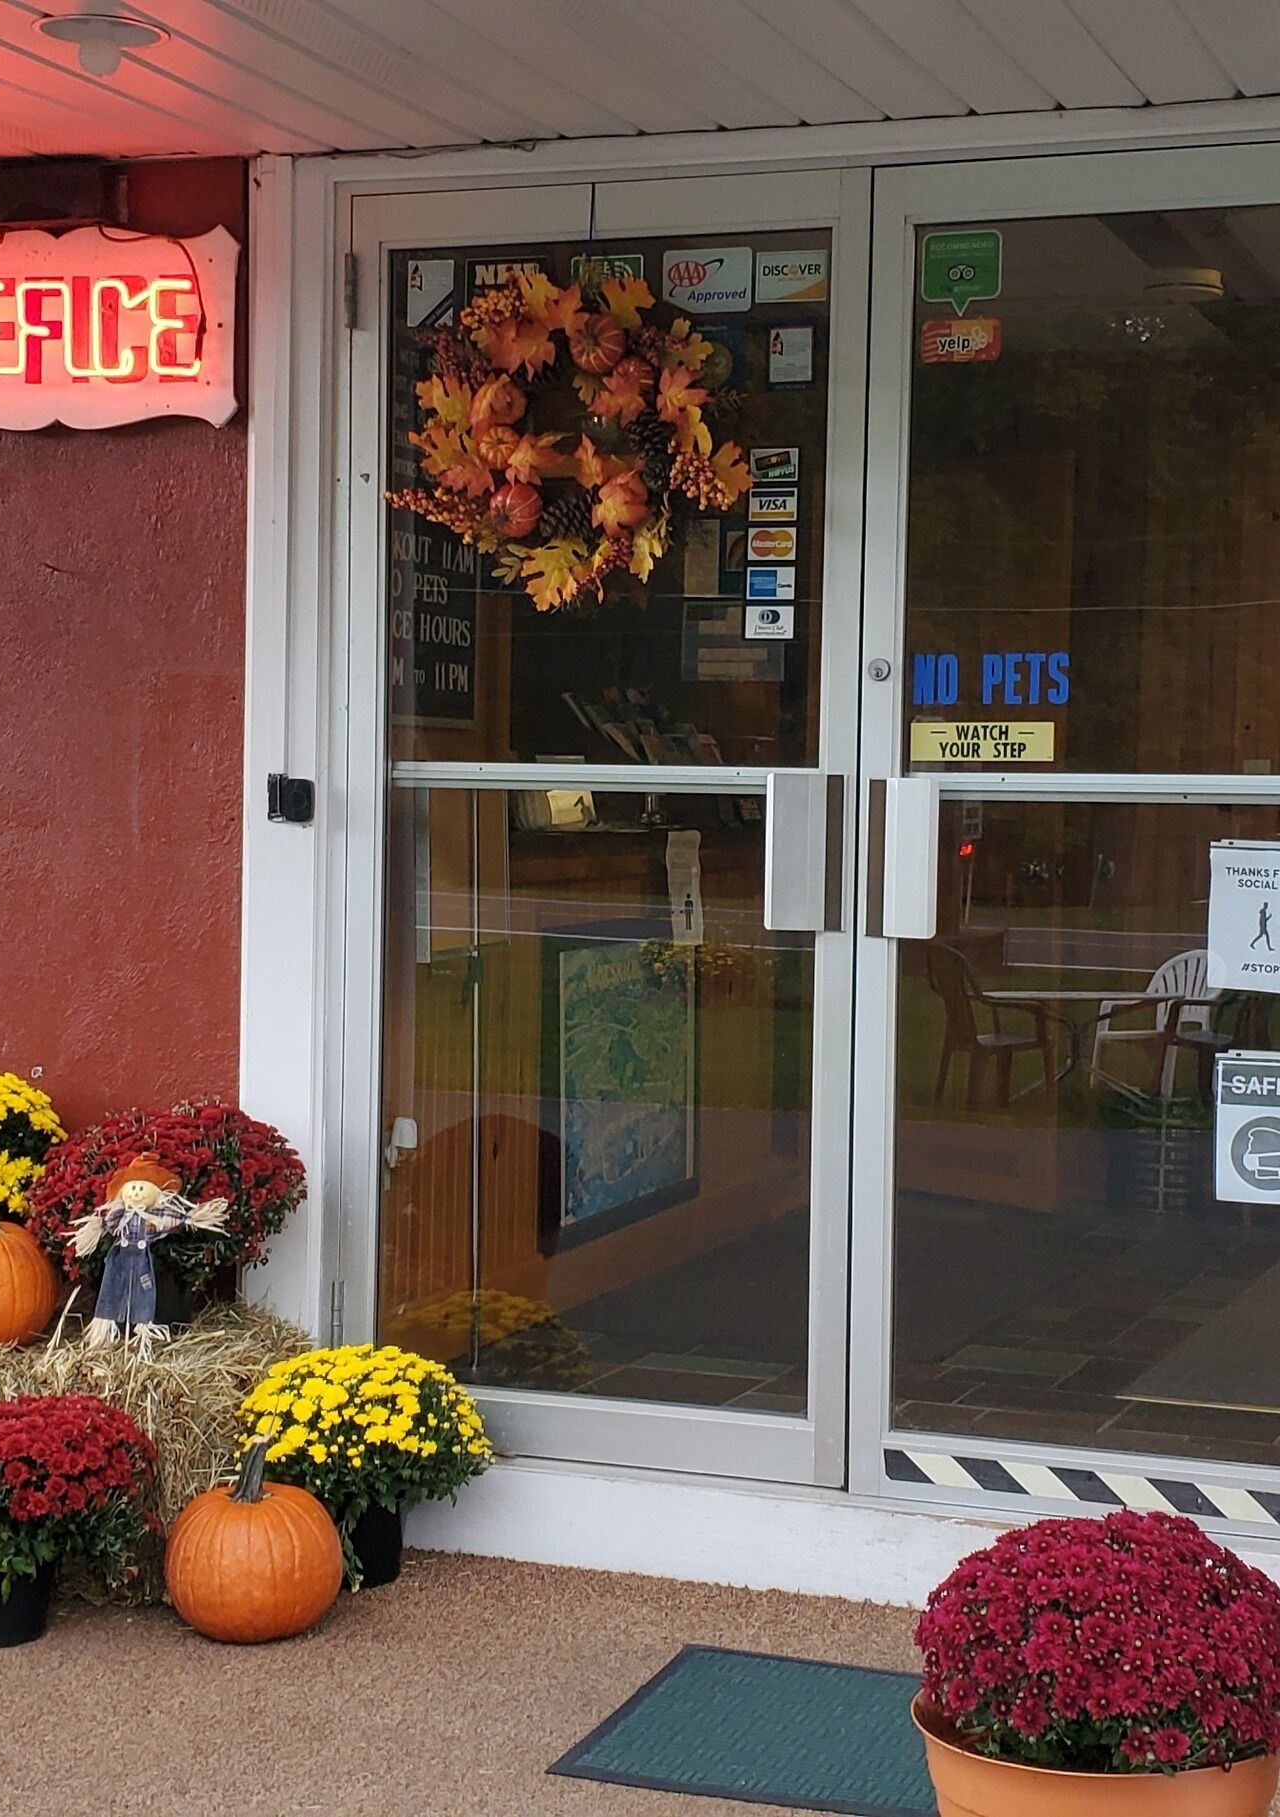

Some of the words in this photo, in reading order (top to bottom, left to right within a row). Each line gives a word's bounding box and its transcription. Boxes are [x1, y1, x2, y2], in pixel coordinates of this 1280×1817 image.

[762, 264, 821, 276] DISCOVER
[687, 287, 747, 303] Approved
[938, 335, 971, 352] yelp
[759, 499, 787, 510] VISA
[413, 572, 449, 605] PETS
[420, 612, 471, 647] HOURS
[414, 669, 426, 684] TO
[913, 653, 958, 705] NO
[982, 653, 1069, 705] PETS
[956, 725, 1009, 741] WATCH
[939, 742, 981, 758] YOUR
[993, 742, 1026, 758] STEP
[1225, 866, 1270, 878] THANKS
[1238, 879, 1278, 890] SOCIAL
